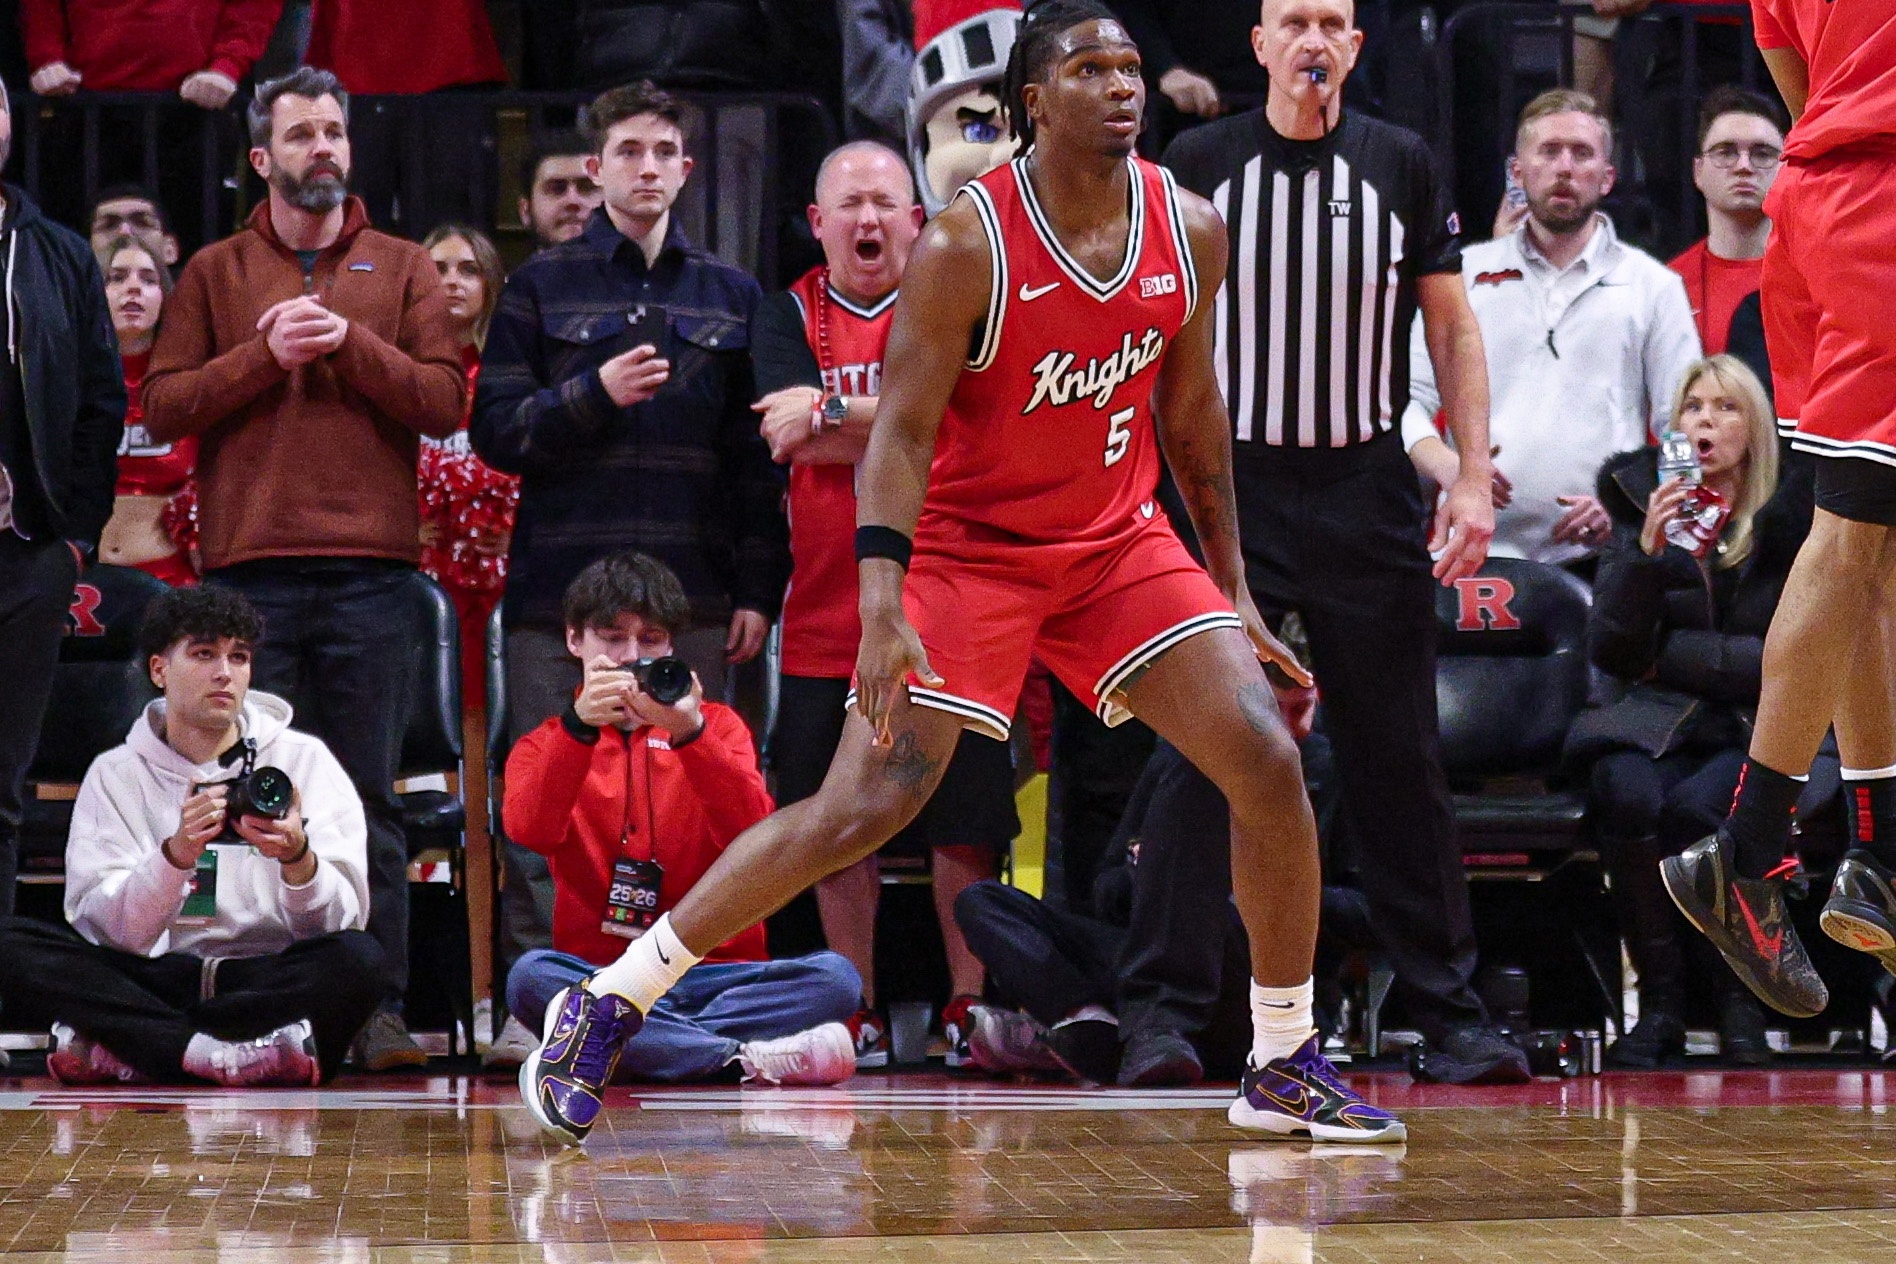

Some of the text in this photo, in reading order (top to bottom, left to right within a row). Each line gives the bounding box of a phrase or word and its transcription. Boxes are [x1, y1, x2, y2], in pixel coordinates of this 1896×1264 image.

[1327, 202, 1351, 216] TW
[1020, 328, 1164, 416] Knights
[1104, 406, 1135, 468] 5
[1453, 577, 1521, 632] R
